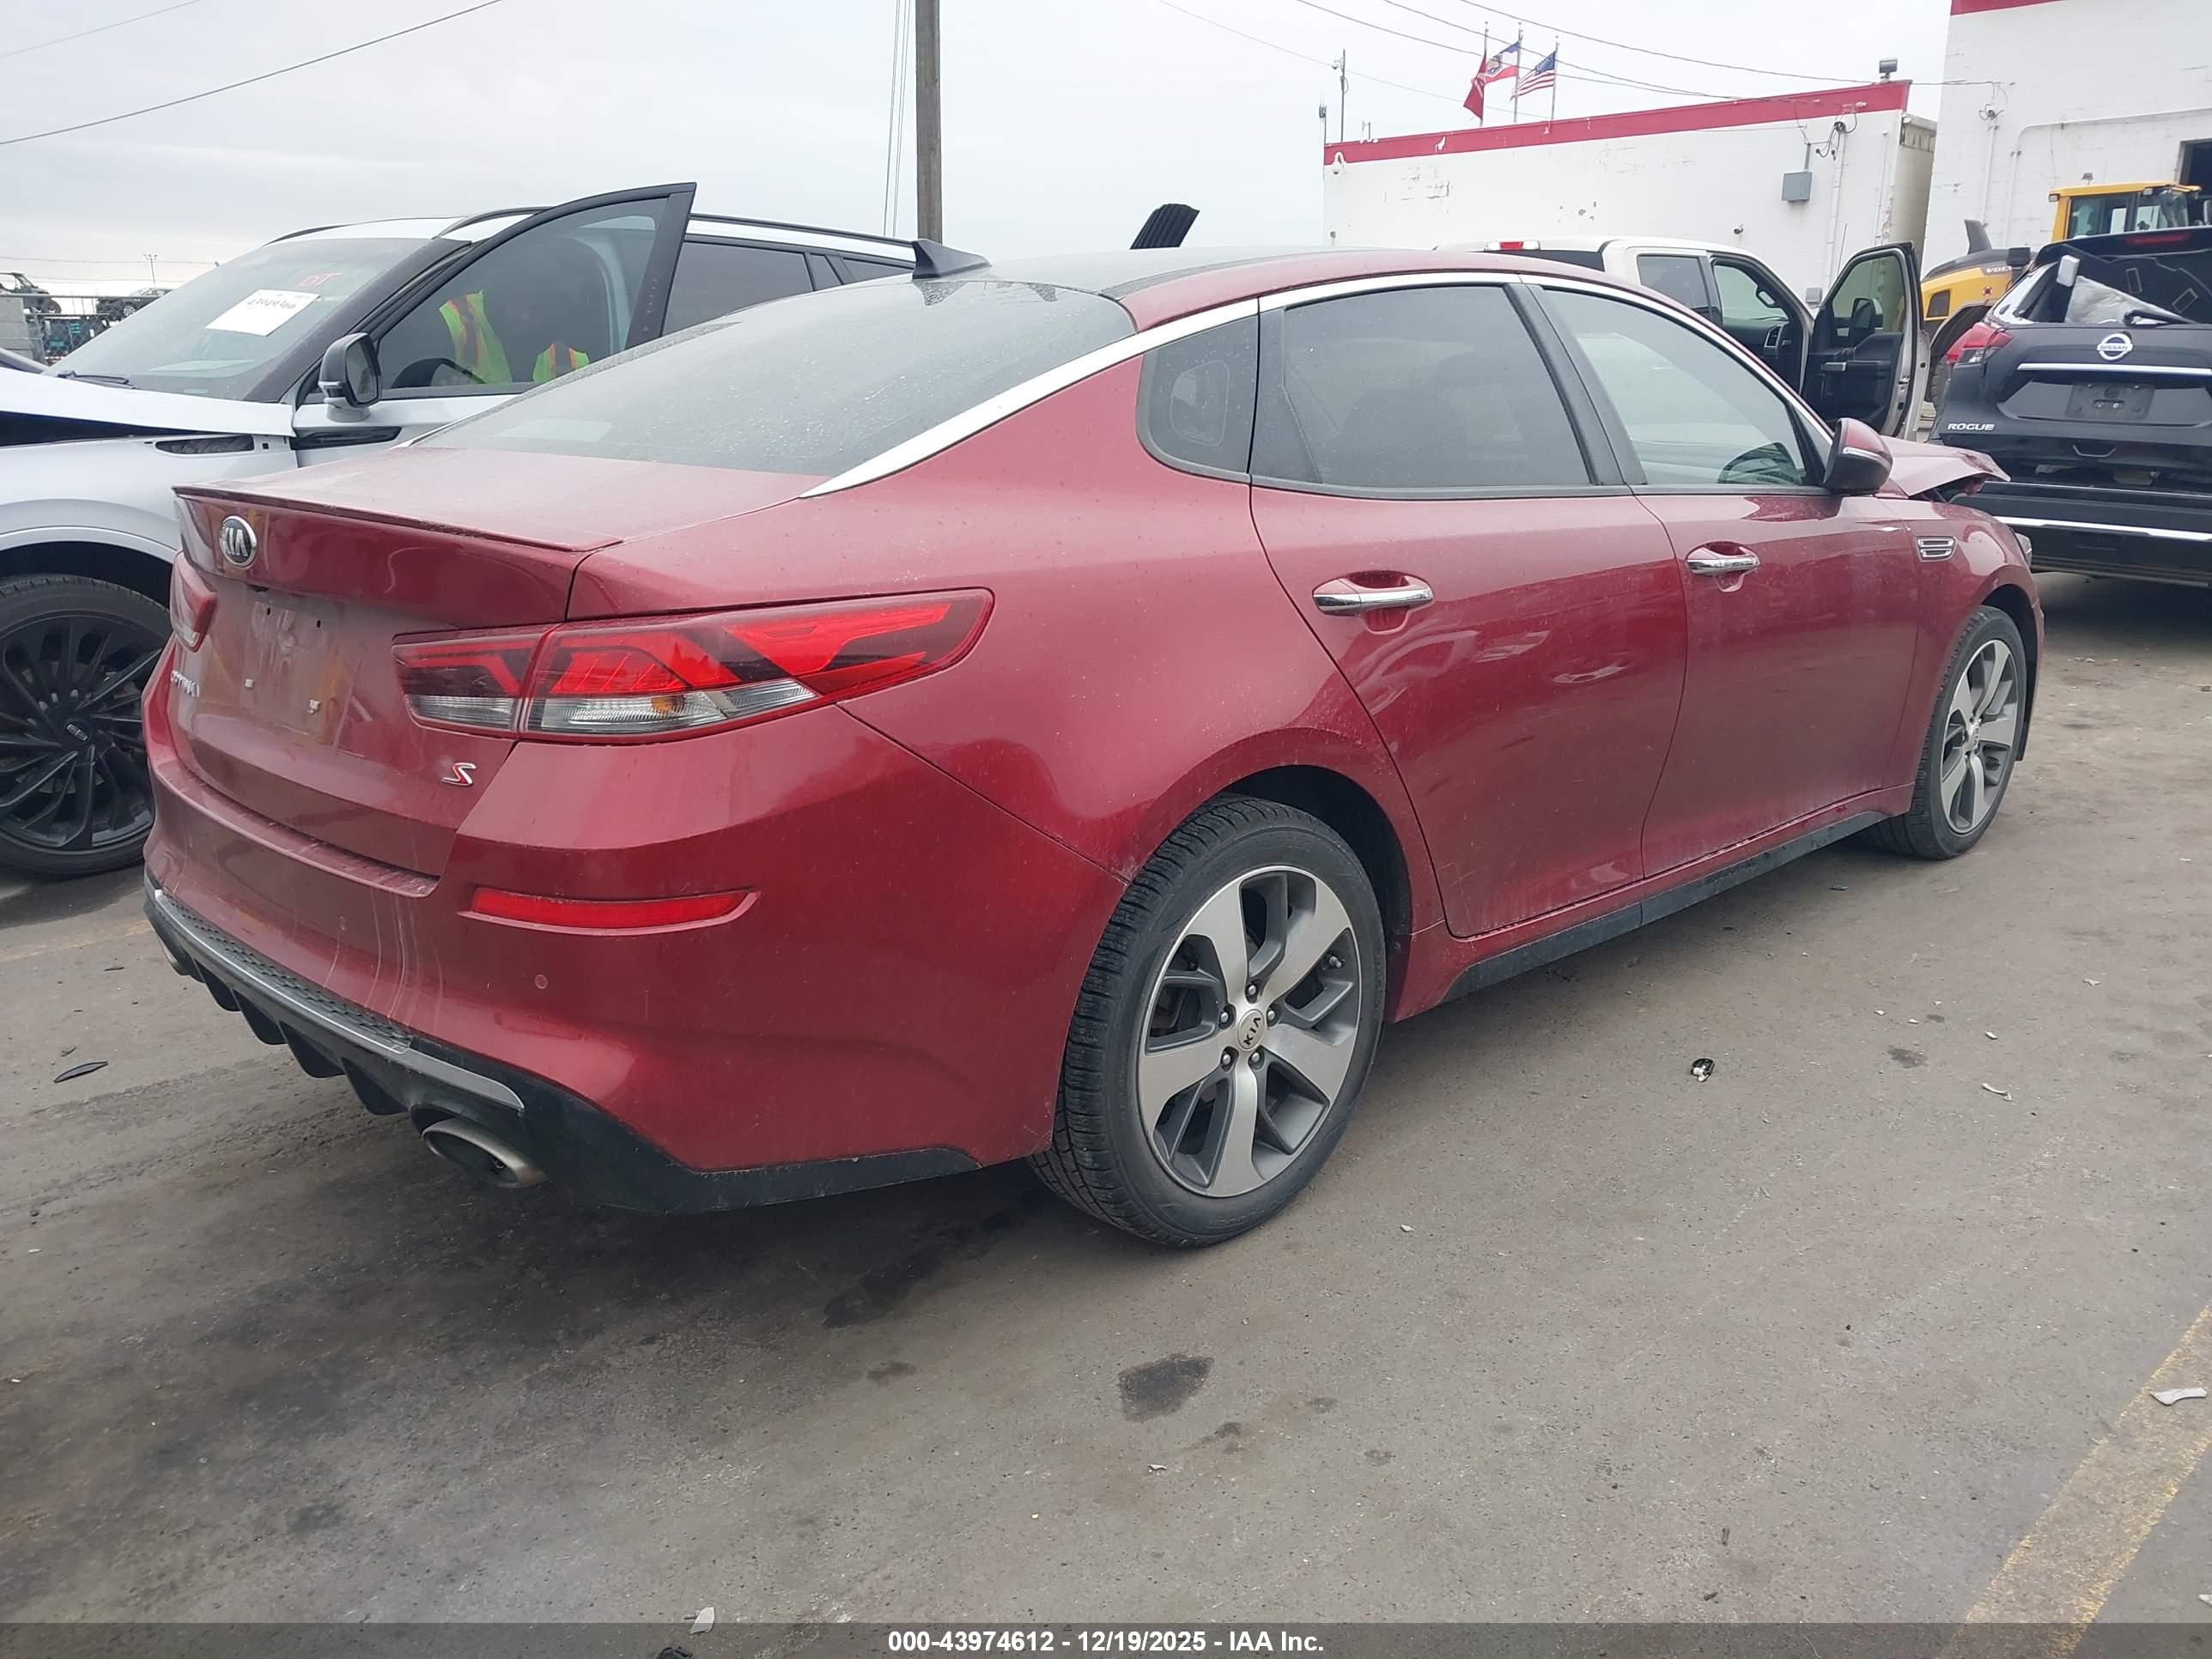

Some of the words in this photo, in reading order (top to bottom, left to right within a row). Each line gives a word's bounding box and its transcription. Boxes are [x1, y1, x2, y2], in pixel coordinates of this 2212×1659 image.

[1947, 422, 1996, 431] ROGUE
[222, 526, 249, 556] KIA
[1243, 1017, 1261, 1046] KIA
